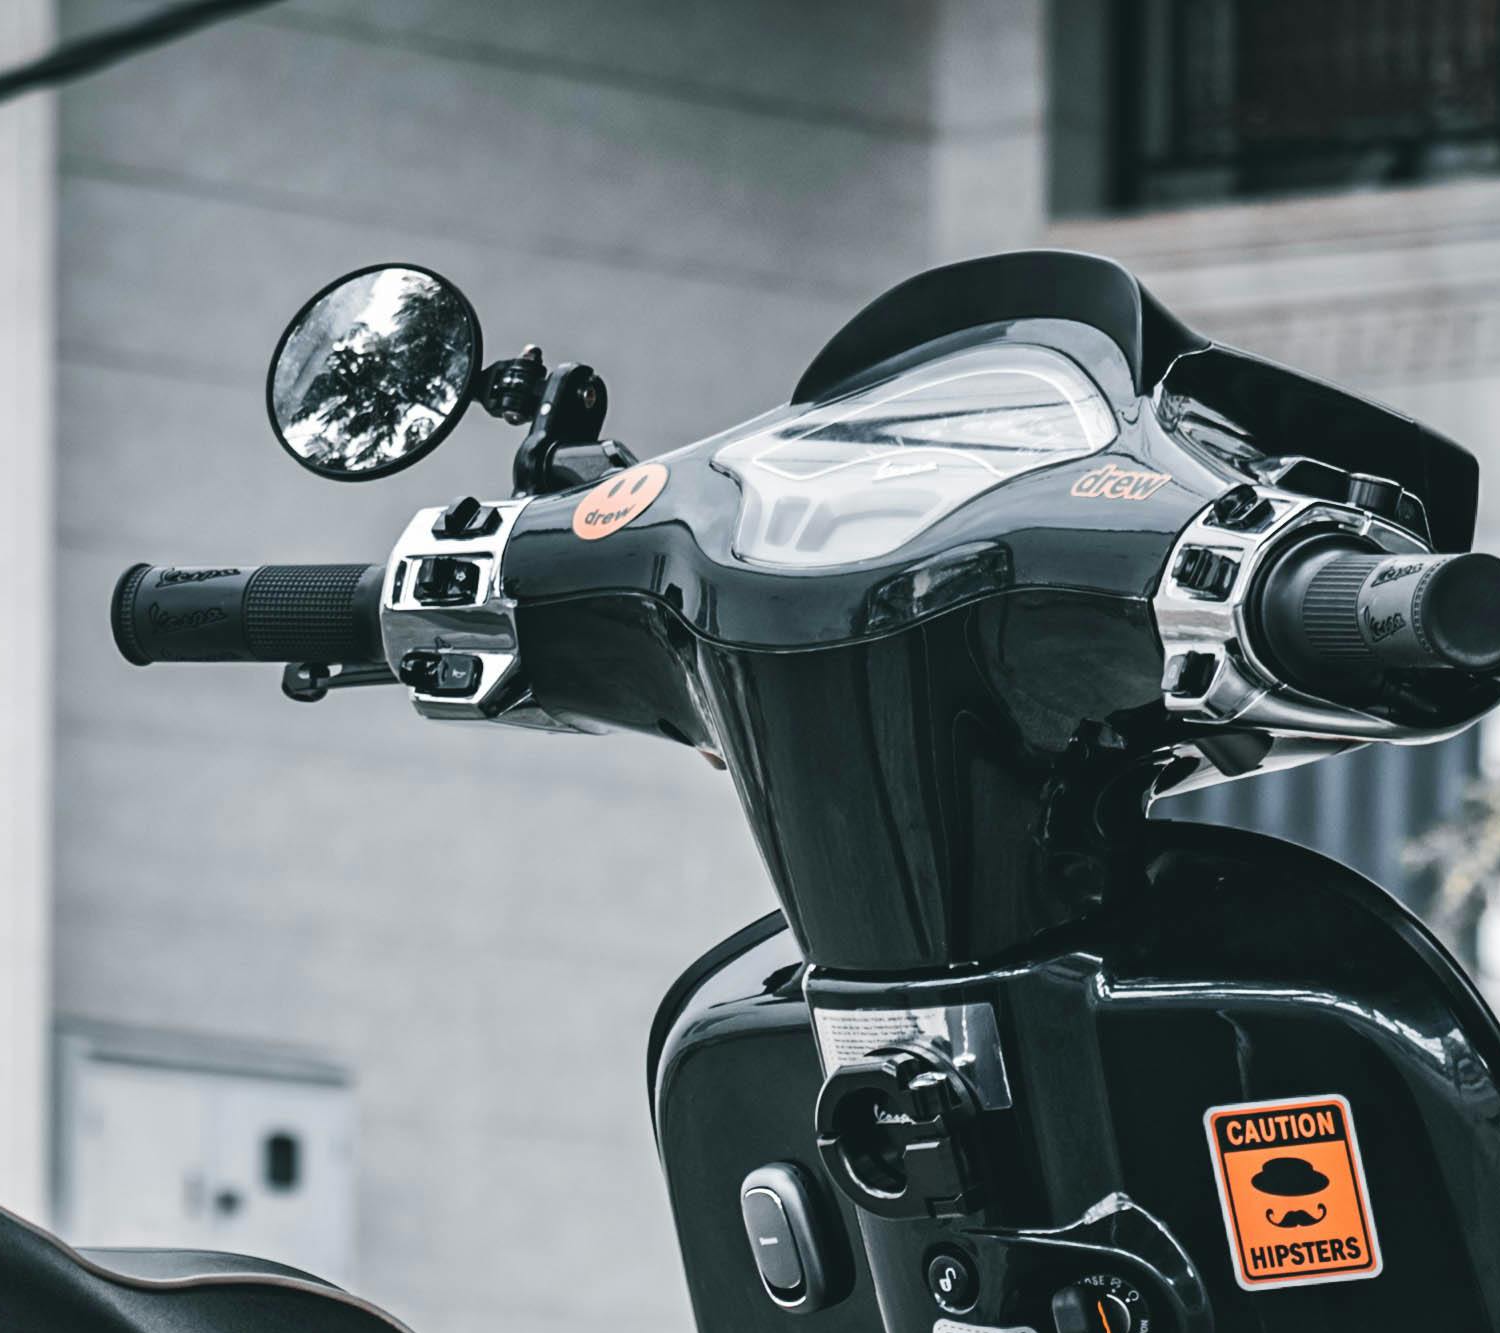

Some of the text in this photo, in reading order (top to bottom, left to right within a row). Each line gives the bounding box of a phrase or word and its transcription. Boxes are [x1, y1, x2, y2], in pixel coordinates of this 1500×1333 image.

[1071, 464, 1172, 500] drew
[584, 504, 636, 526] drew
[1226, 1111, 1336, 1146] CAUTION
[1250, 1236, 1362, 1270] HIPSTERS
